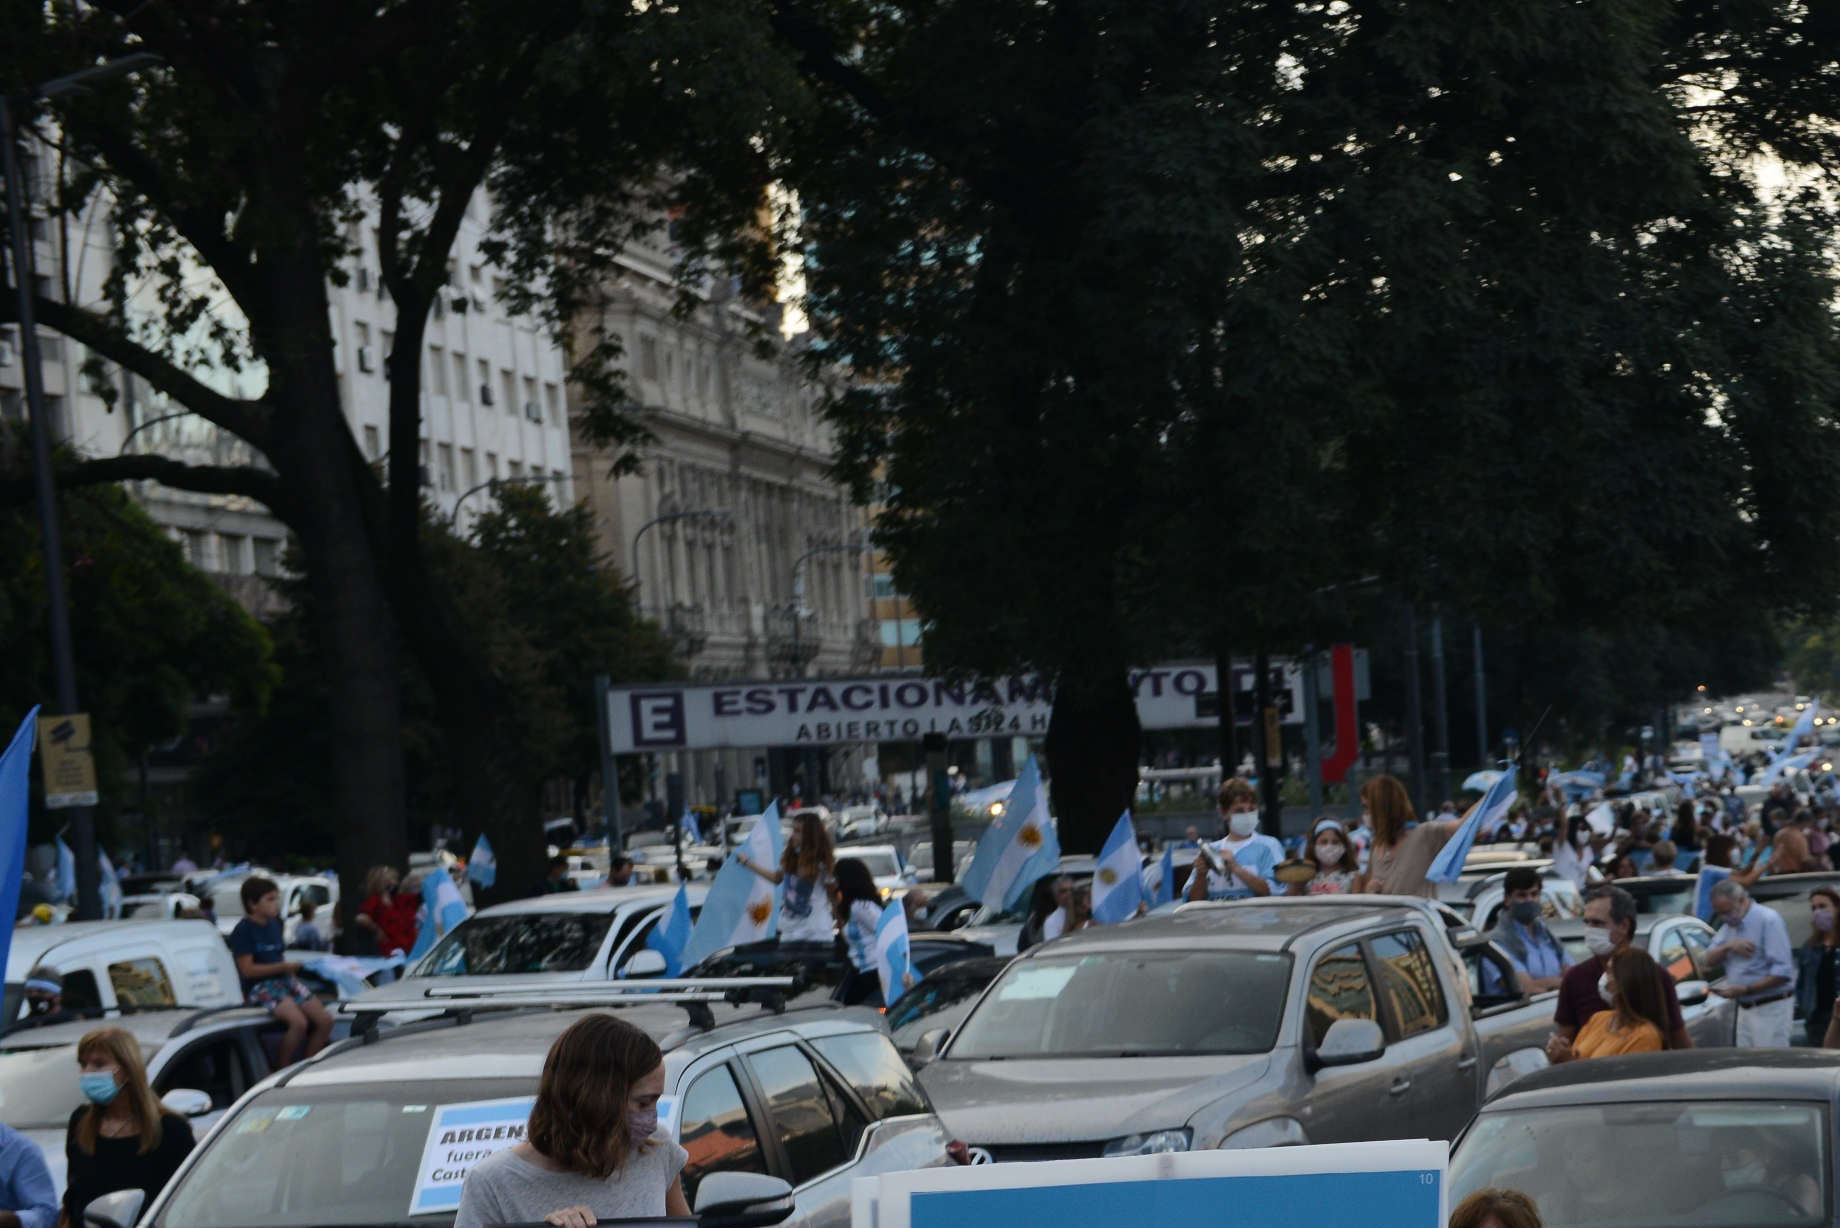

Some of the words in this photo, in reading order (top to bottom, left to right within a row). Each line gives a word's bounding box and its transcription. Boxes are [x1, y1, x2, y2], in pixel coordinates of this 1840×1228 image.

[712, 669, 1207, 717] ESTACIONAMTO
[796, 717, 920, 742] ABIERTO
[440, 1125, 528, 1145] ARGEN
[1418, 1172, 1434, 1185] 10
